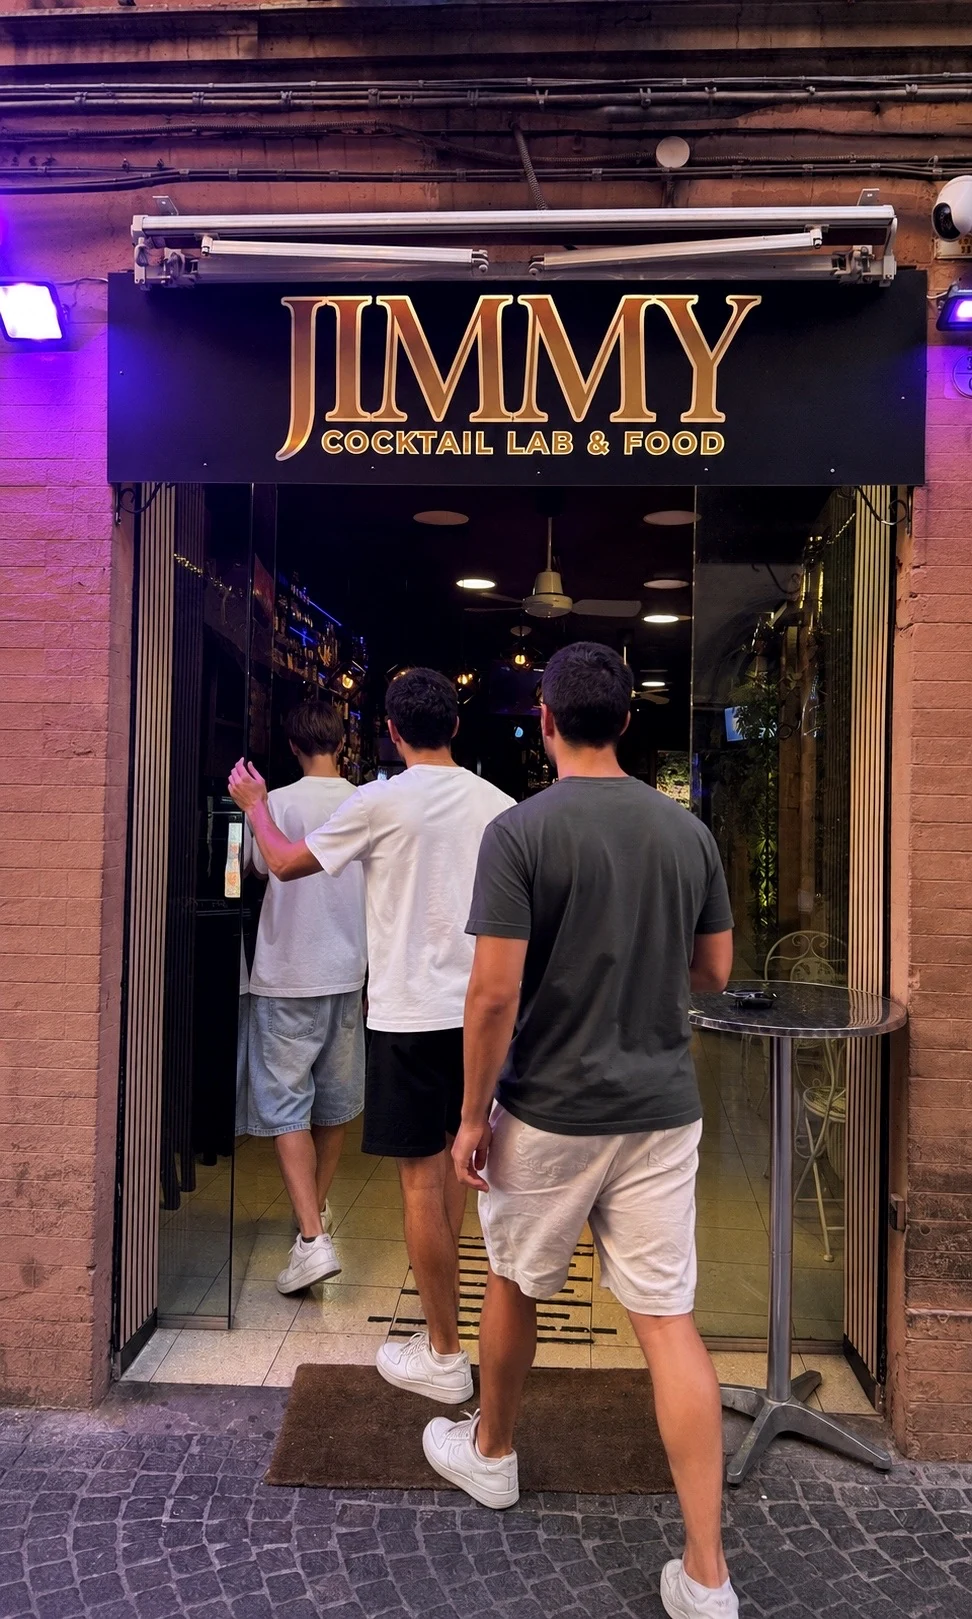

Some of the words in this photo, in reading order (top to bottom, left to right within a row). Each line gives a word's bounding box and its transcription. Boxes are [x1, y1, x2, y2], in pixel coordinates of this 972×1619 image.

[276, 295, 762, 461] JIMMY
[321, 430, 493, 455] COCKTAIL
[507, 431, 573, 455] LAB
[587, 431, 610, 455] &
[624, 431, 725, 455] FOOD
